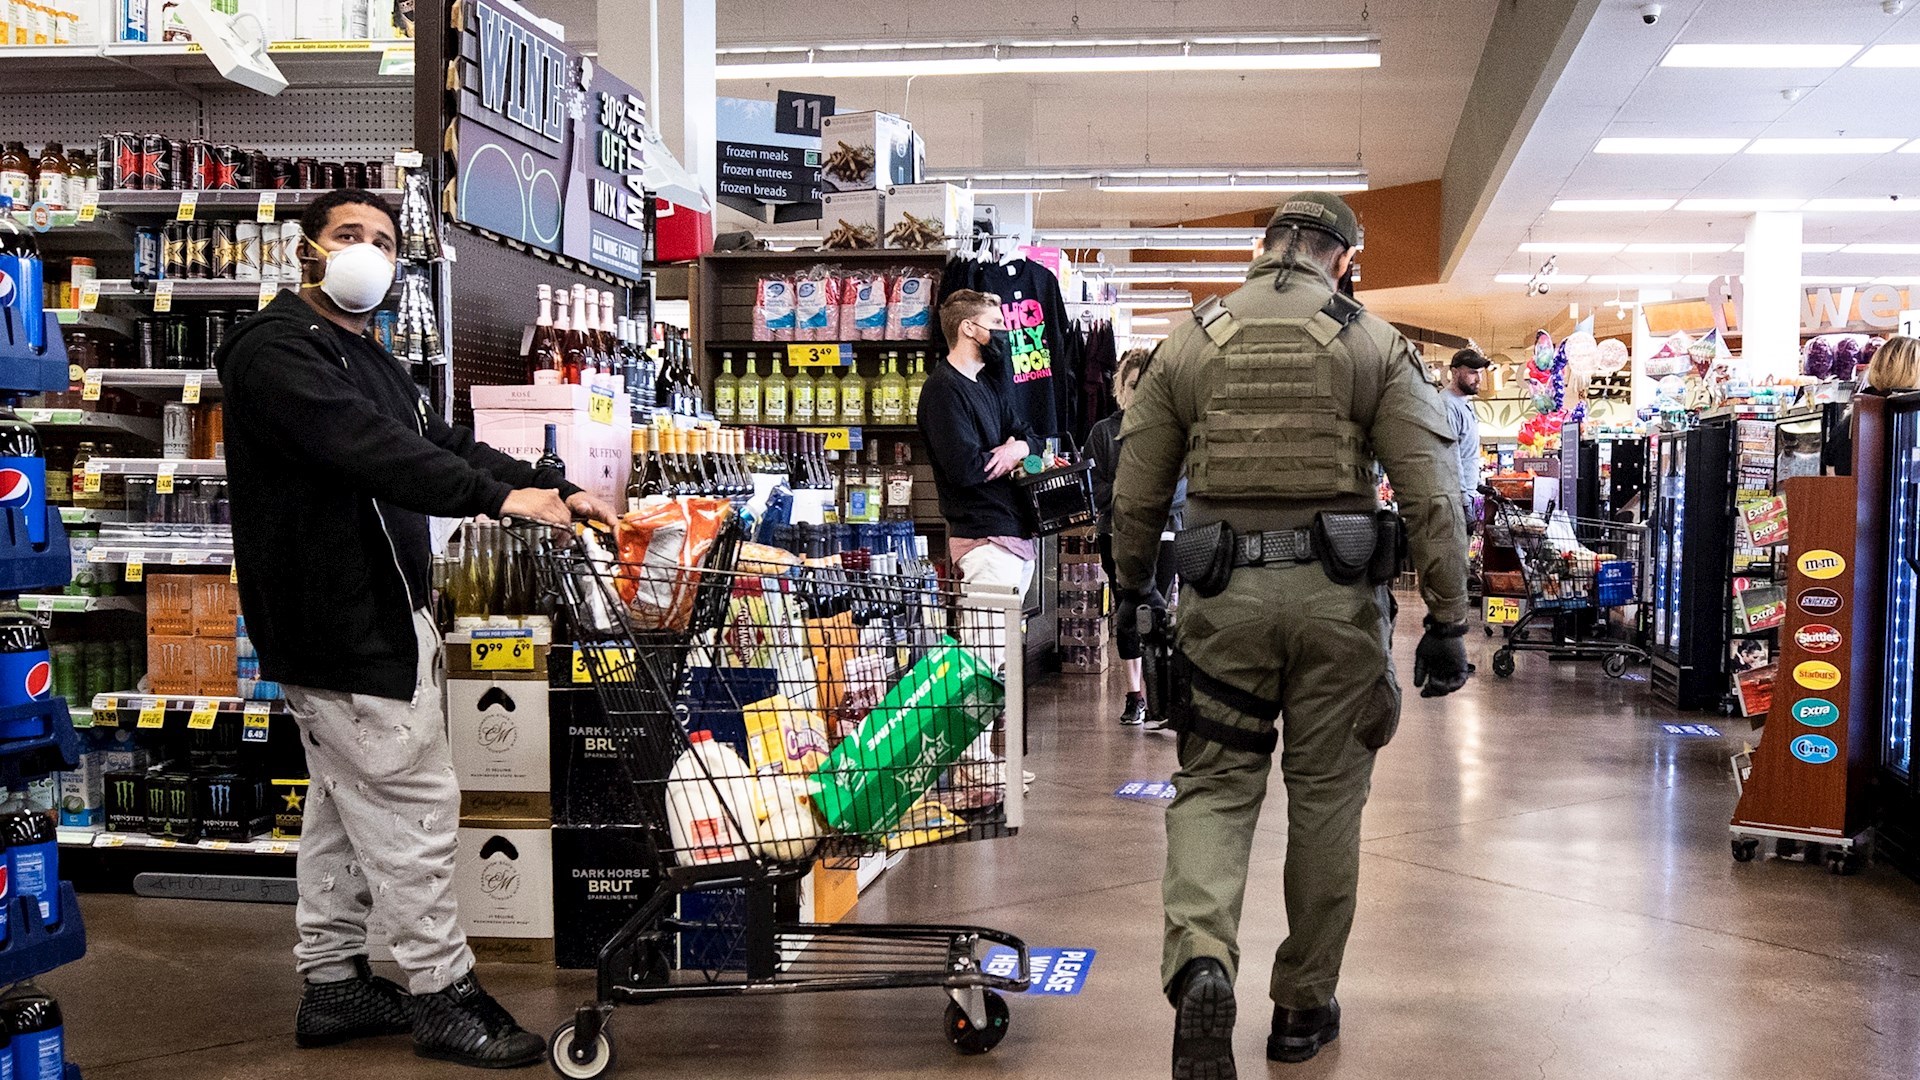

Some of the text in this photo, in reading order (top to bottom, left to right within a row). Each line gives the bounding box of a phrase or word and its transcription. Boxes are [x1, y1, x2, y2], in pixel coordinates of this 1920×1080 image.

[477, 1, 566, 143] WINE
[600, 91, 628, 136] 30%
[791, 98, 821, 130] 11
[602, 129, 626, 174] OFF
[726, 144, 789, 162] frozen meals
[593, 94, 646, 231] MIX & MATCH
[722, 163, 793, 180] frozen entrees
[719, 181, 787, 198] frozen breads
[1285, 201, 1322, 217] MARCUS
[139, 233, 157, 277] NOS
[1013, 367, 1053, 384] CALIFORNI
[511, 390, 531, 398] ROSÉ
[499, 446, 545, 454] RUFFIN
[589, 446, 623, 459] RUFFINO
[1747, 501, 1774, 521] Extra
[1753, 521, 1779, 541] Extra
[1802, 597, 1837, 606] SNICKERS
[1750, 606, 1776, 626] Extra
[1798, 632, 1840, 644] Skittles
[94, 711, 118, 723] 15.99
[247, 715, 266, 724] 7.49
[867, 673, 938, 752] LEMON-LIME
[1799, 705, 1831, 718] Extra
[141, 716, 162, 724] FREE
[192, 717, 212, 725] FREE
[247, 729, 265, 739] 6.49
[569, 726, 602, 736] DARK
[1796, 739, 1830, 757] Orbit
[109, 814, 145, 823] MONSTER
[202, 820, 240, 828] MONSTER
[572, 868, 651, 879] DARK HORSE
[588, 879, 633, 893] BRUT
[986, 954, 1019, 977] HER
[1043, 951, 1087, 992] PLEASE
